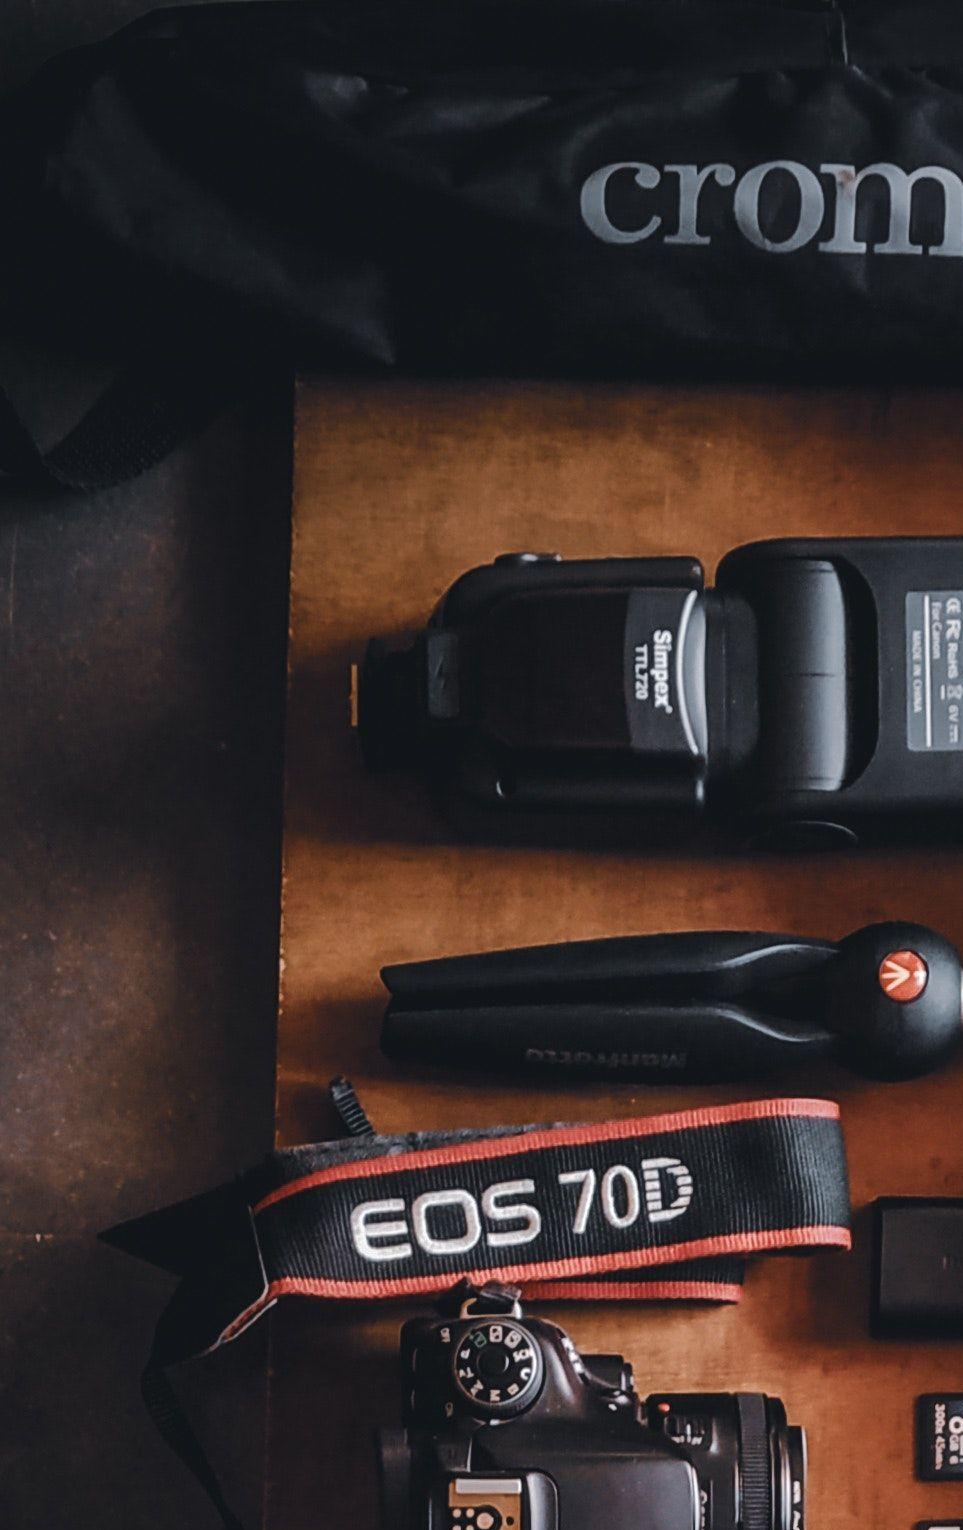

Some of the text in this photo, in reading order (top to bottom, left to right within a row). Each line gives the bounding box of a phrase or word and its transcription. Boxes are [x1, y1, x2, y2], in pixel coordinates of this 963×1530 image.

[931, 601, 942, 659] For Canon
[634, 644, 649, 700] TTL720
[650, 630, 672, 707] Simpex
[912, 630, 922, 713] MADE IN CHINA
[948, 642, 959, 721] RoHS 6V
[349, 1156, 694, 1262] EOS 70D
[490, 1390, 500, 1401] M
[934, 1403, 946, 1435] 300x
